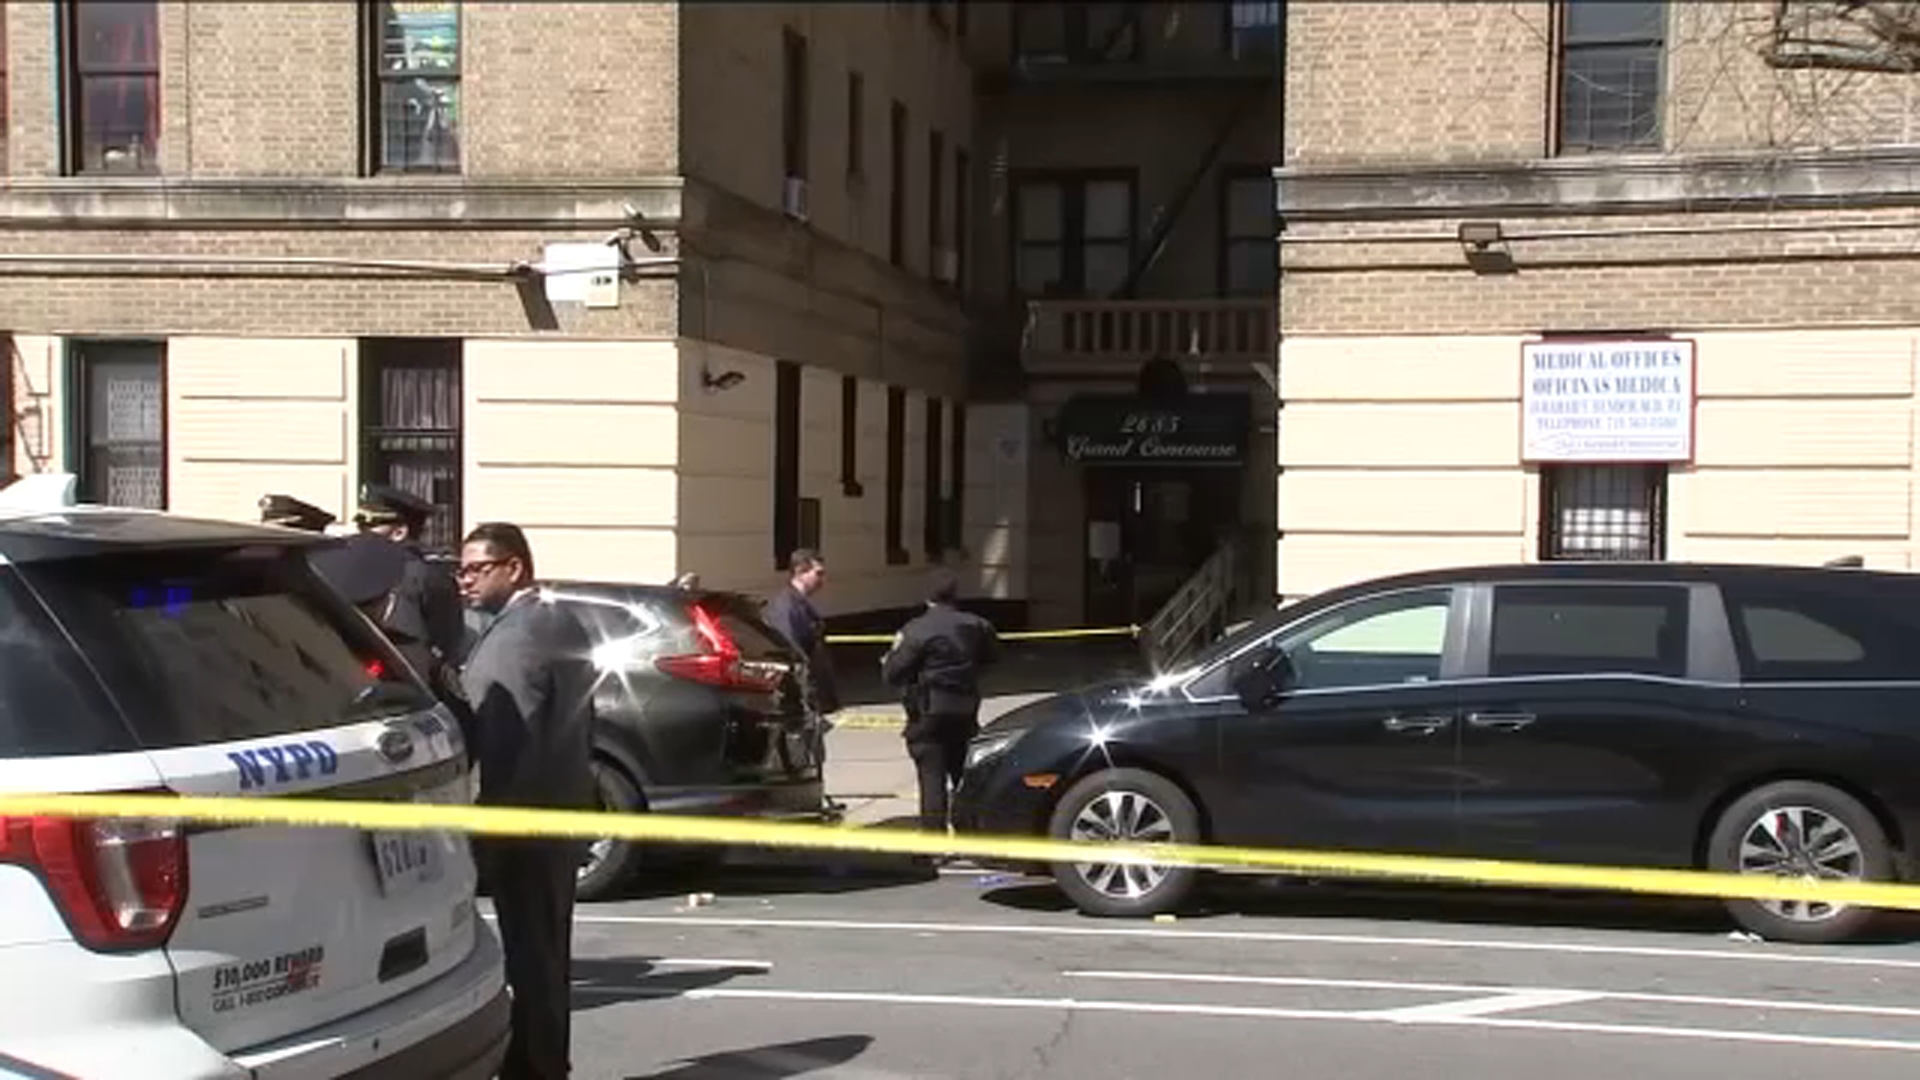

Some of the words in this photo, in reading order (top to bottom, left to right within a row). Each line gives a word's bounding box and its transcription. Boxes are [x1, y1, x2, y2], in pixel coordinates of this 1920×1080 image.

[1532, 351, 1608, 370] MEDICAL
[1610, 349, 1682, 369] OFFICES
[1532, 376, 1611, 396] OFICINAS
[1614, 375, 1681, 395] MEDICA
[1067, 434, 1134, 461] Grand
[1139, 435, 1237, 457] Concourse
[227, 740, 339, 789] NYPD
[213, 958, 271, 990] $10,000
